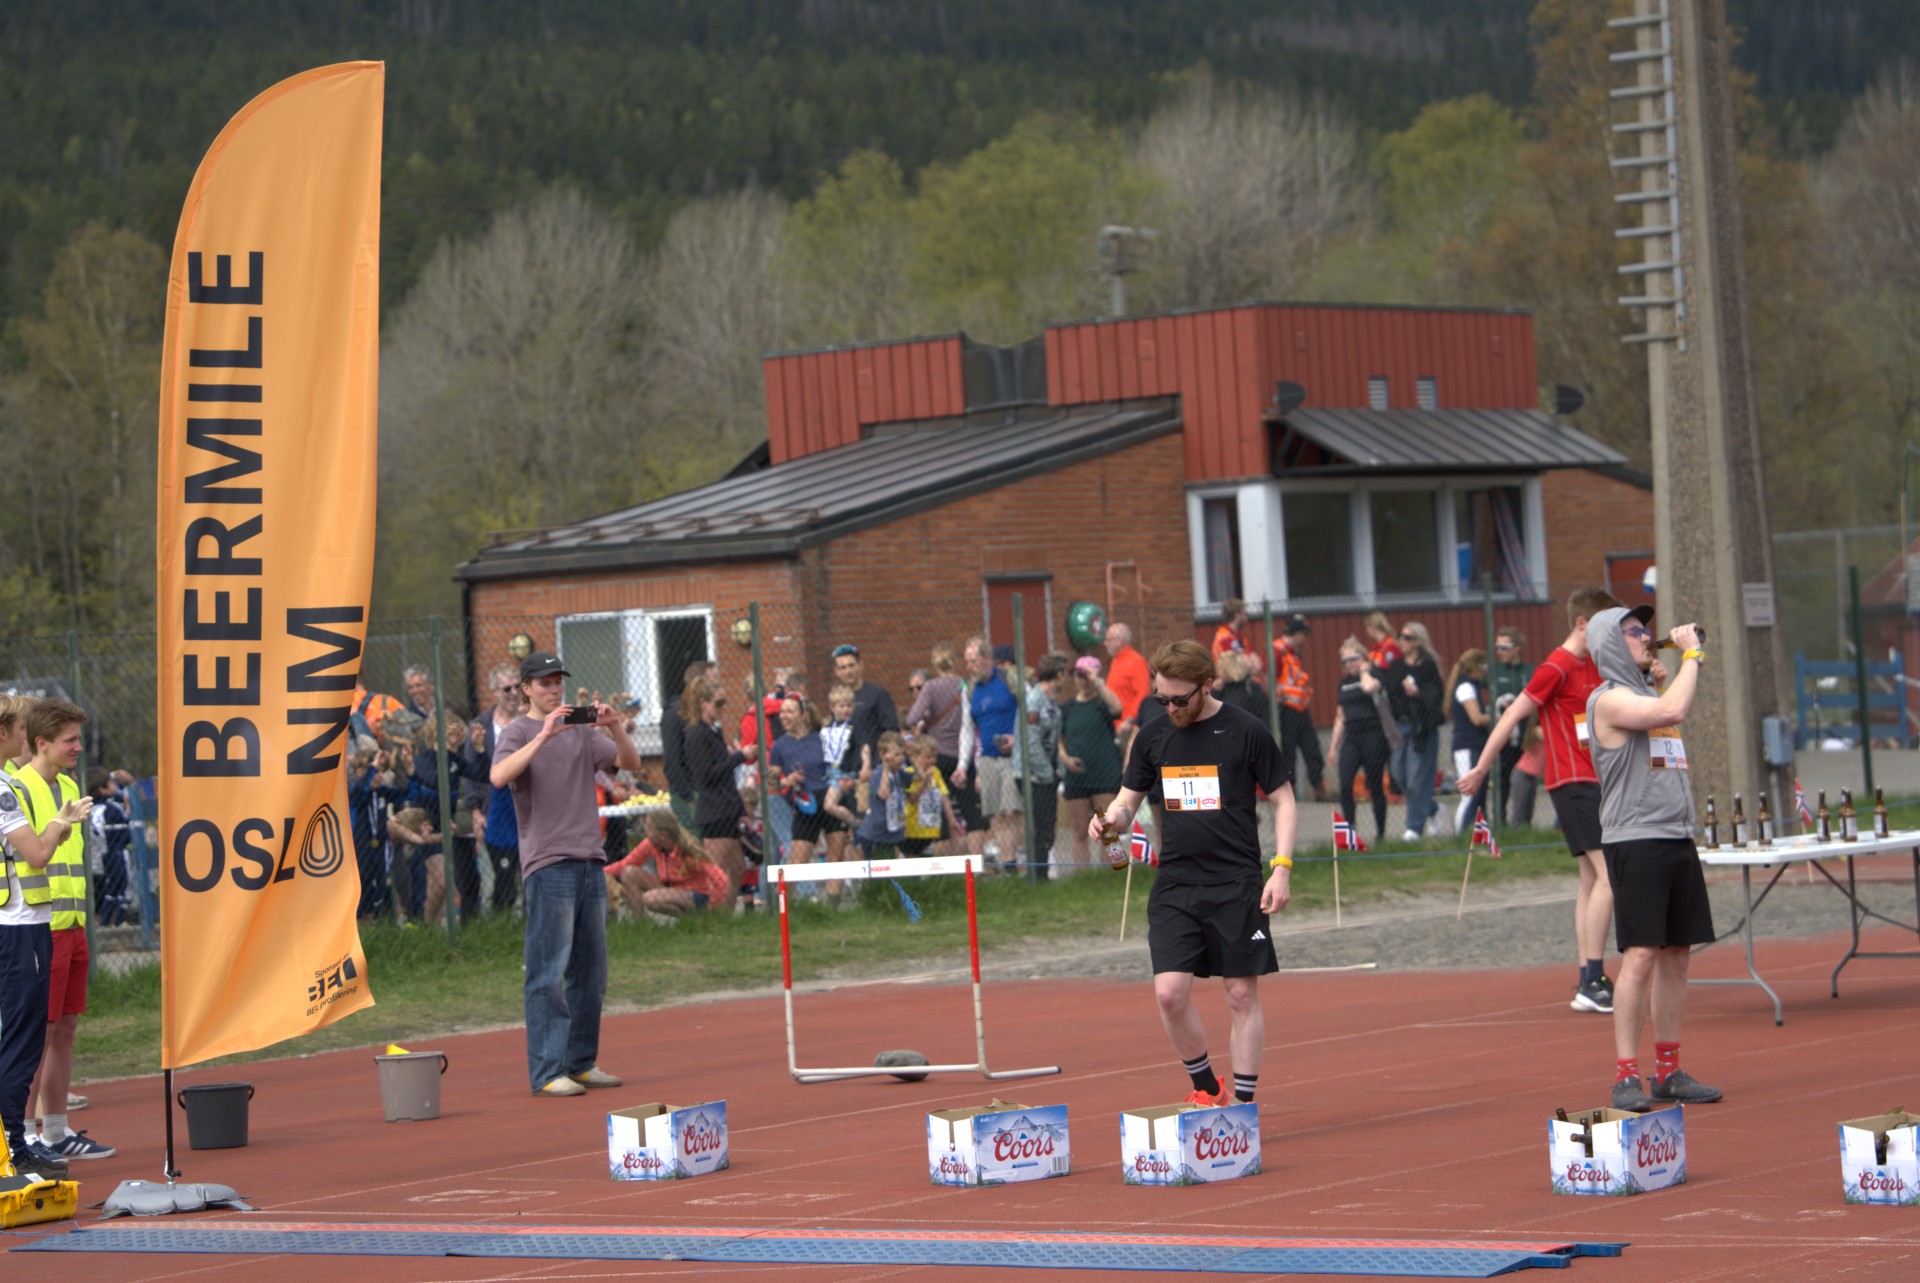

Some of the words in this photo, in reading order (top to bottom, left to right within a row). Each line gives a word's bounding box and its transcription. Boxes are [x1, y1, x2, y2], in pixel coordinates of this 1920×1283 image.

[182, 251, 264, 777] BEERMILE
[287, 606, 364, 775] NM
[1664, 739, 1674, 755] 12
[1182, 781, 1193, 796] 11
[173, 803, 344, 893] OSLO
[307, 1005, 319, 1016] BEL
[683, 1125, 721, 1155] Coors
[993, 1132, 1055, 1162] Coors
[1194, 1128, 1249, 1160] Coors
[623, 1152, 661, 1169] Coors
[1637, 1134, 1678, 1168] Coors
[939, 1156, 969, 1174] Coors
[1134, 1155, 1171, 1173] Coors
[1566, 1163, 1610, 1182] Coors
[1858, 1171, 1905, 1191] Coors
